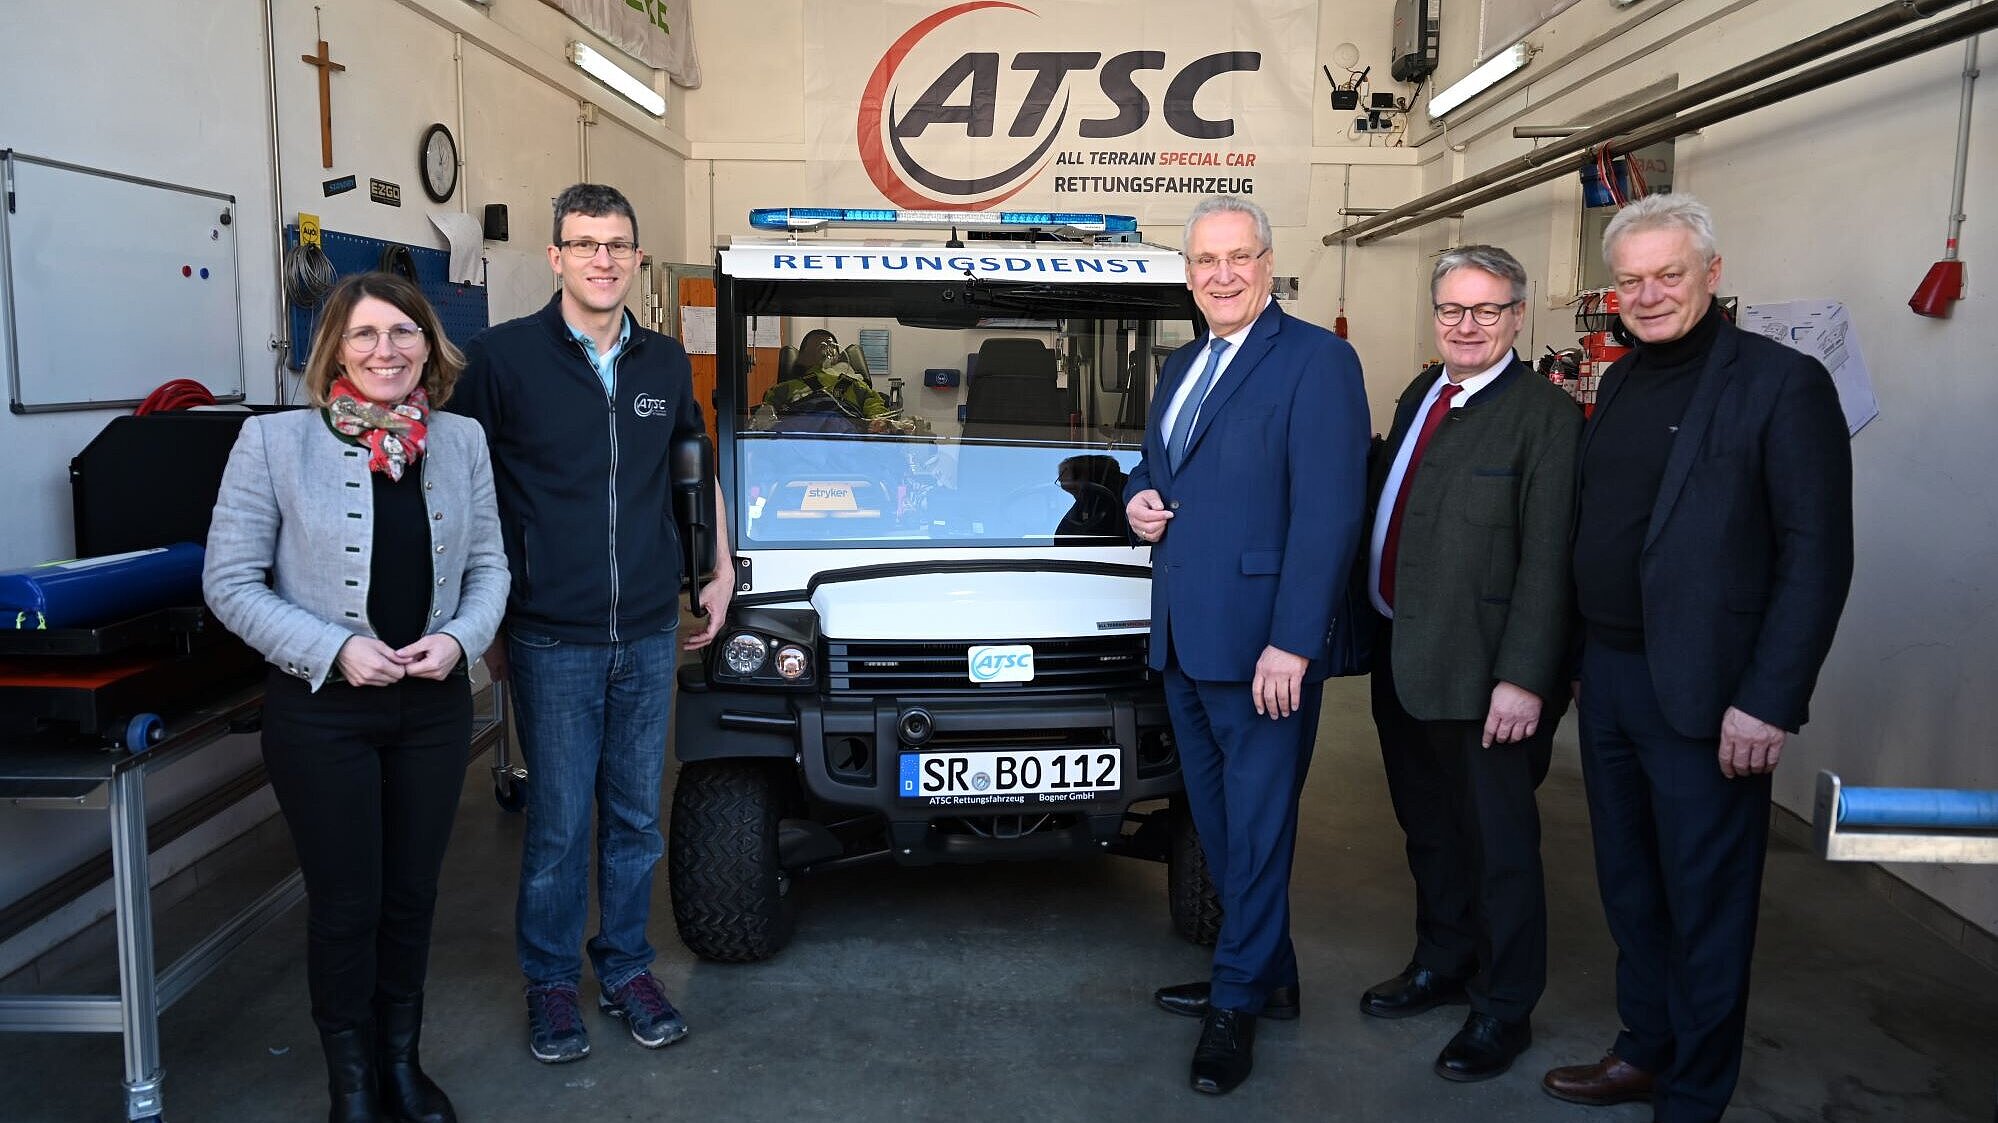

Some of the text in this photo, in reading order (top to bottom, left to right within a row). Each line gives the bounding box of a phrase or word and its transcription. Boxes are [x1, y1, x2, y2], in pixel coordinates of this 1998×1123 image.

[896, 50, 1262, 139] ATSC
[1056, 152, 1257, 167] ALL TERRAIN SPECIAL CAR
[1055, 176, 1253, 194] RETTUNGSFAHRZEUG
[773, 255, 1150, 274] RETTUNGSDIENST
[637, 398, 666, 410] ATSC
[808, 488, 848, 498] stryker
[976, 653, 1031, 669] ATSC
[923, 754, 1116, 792] SR BO 112
[905, 781, 913, 790] D
[929, 791, 1095, 805] ATSC Rettungsfahrzeug Bogner GmbH
